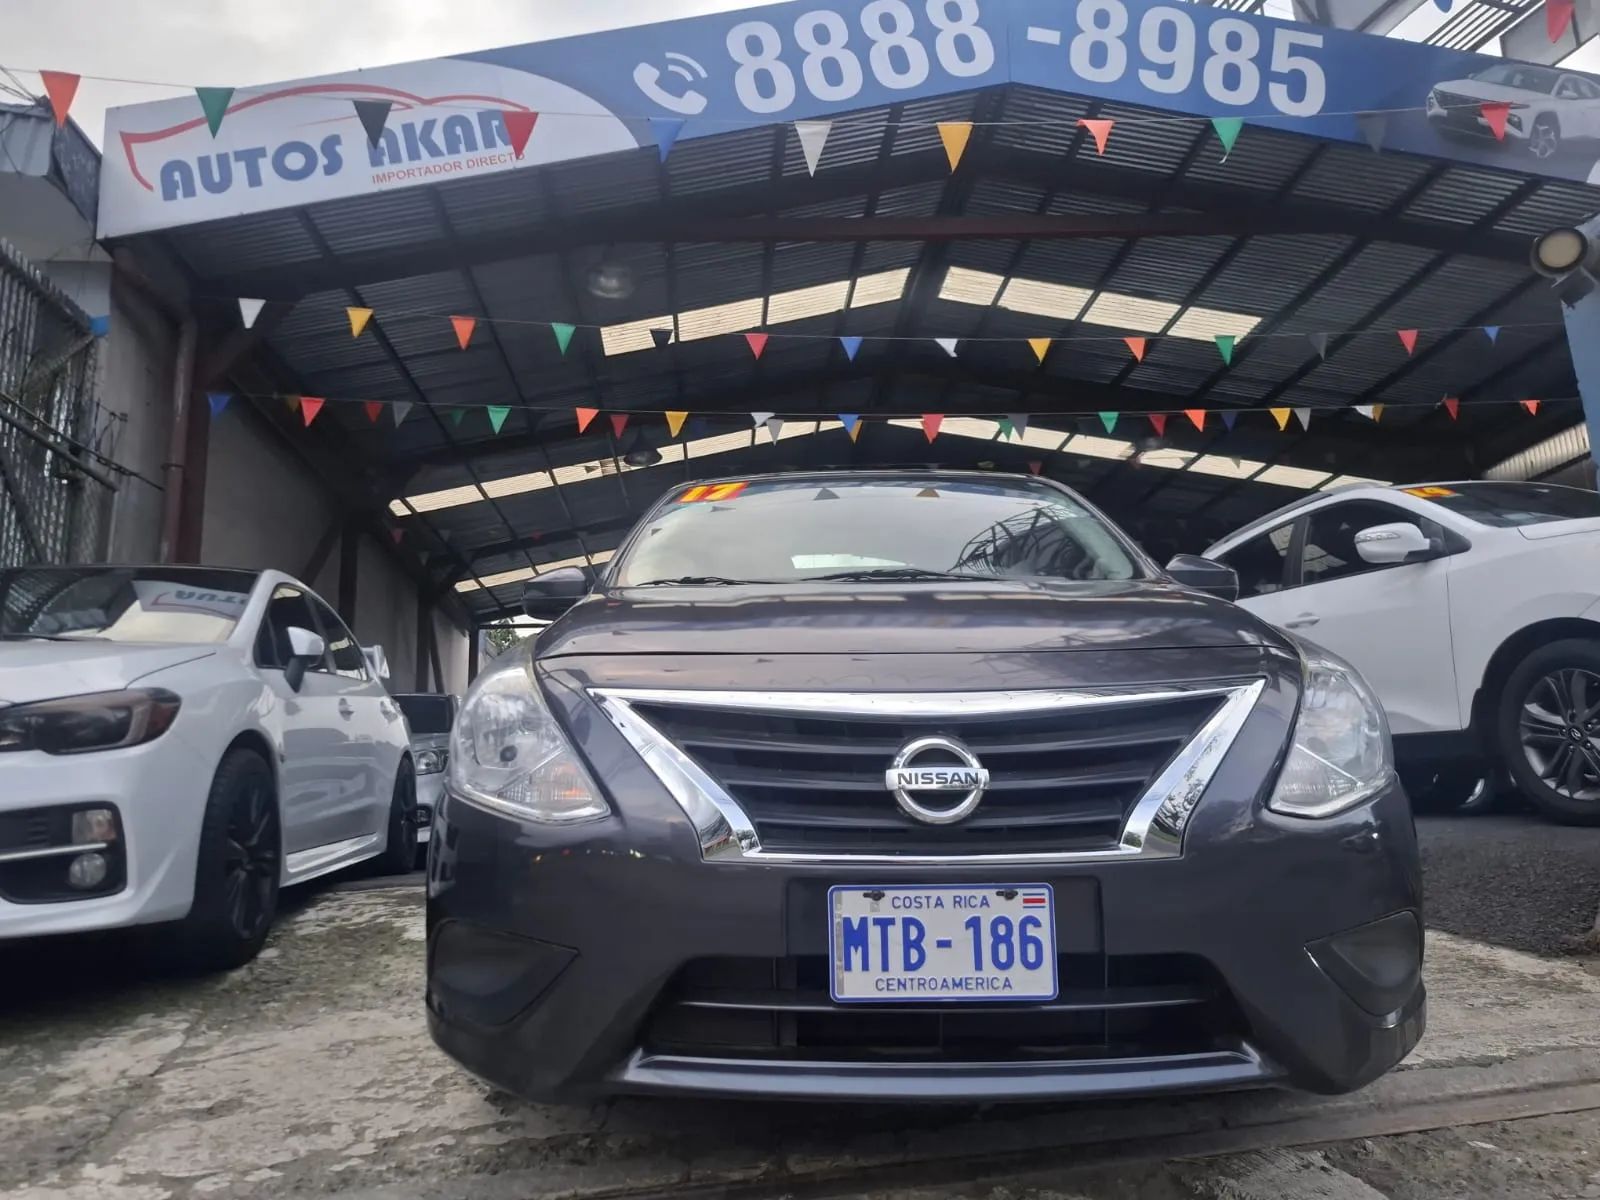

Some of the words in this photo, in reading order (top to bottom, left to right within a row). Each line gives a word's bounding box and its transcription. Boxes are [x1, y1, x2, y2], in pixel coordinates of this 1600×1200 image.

[160, 134, 343, 201] AUTOS
[372, 160, 463, 185] IMPORTADOR
[897, 772, 979, 785] NISSAN
[891, 896, 945, 909] COSTA
[953, 895, 990, 908] RICA
[842, 915, 1043, 972] MTB-186
[875, 977, 1012, 992] CENTROAMERICA
